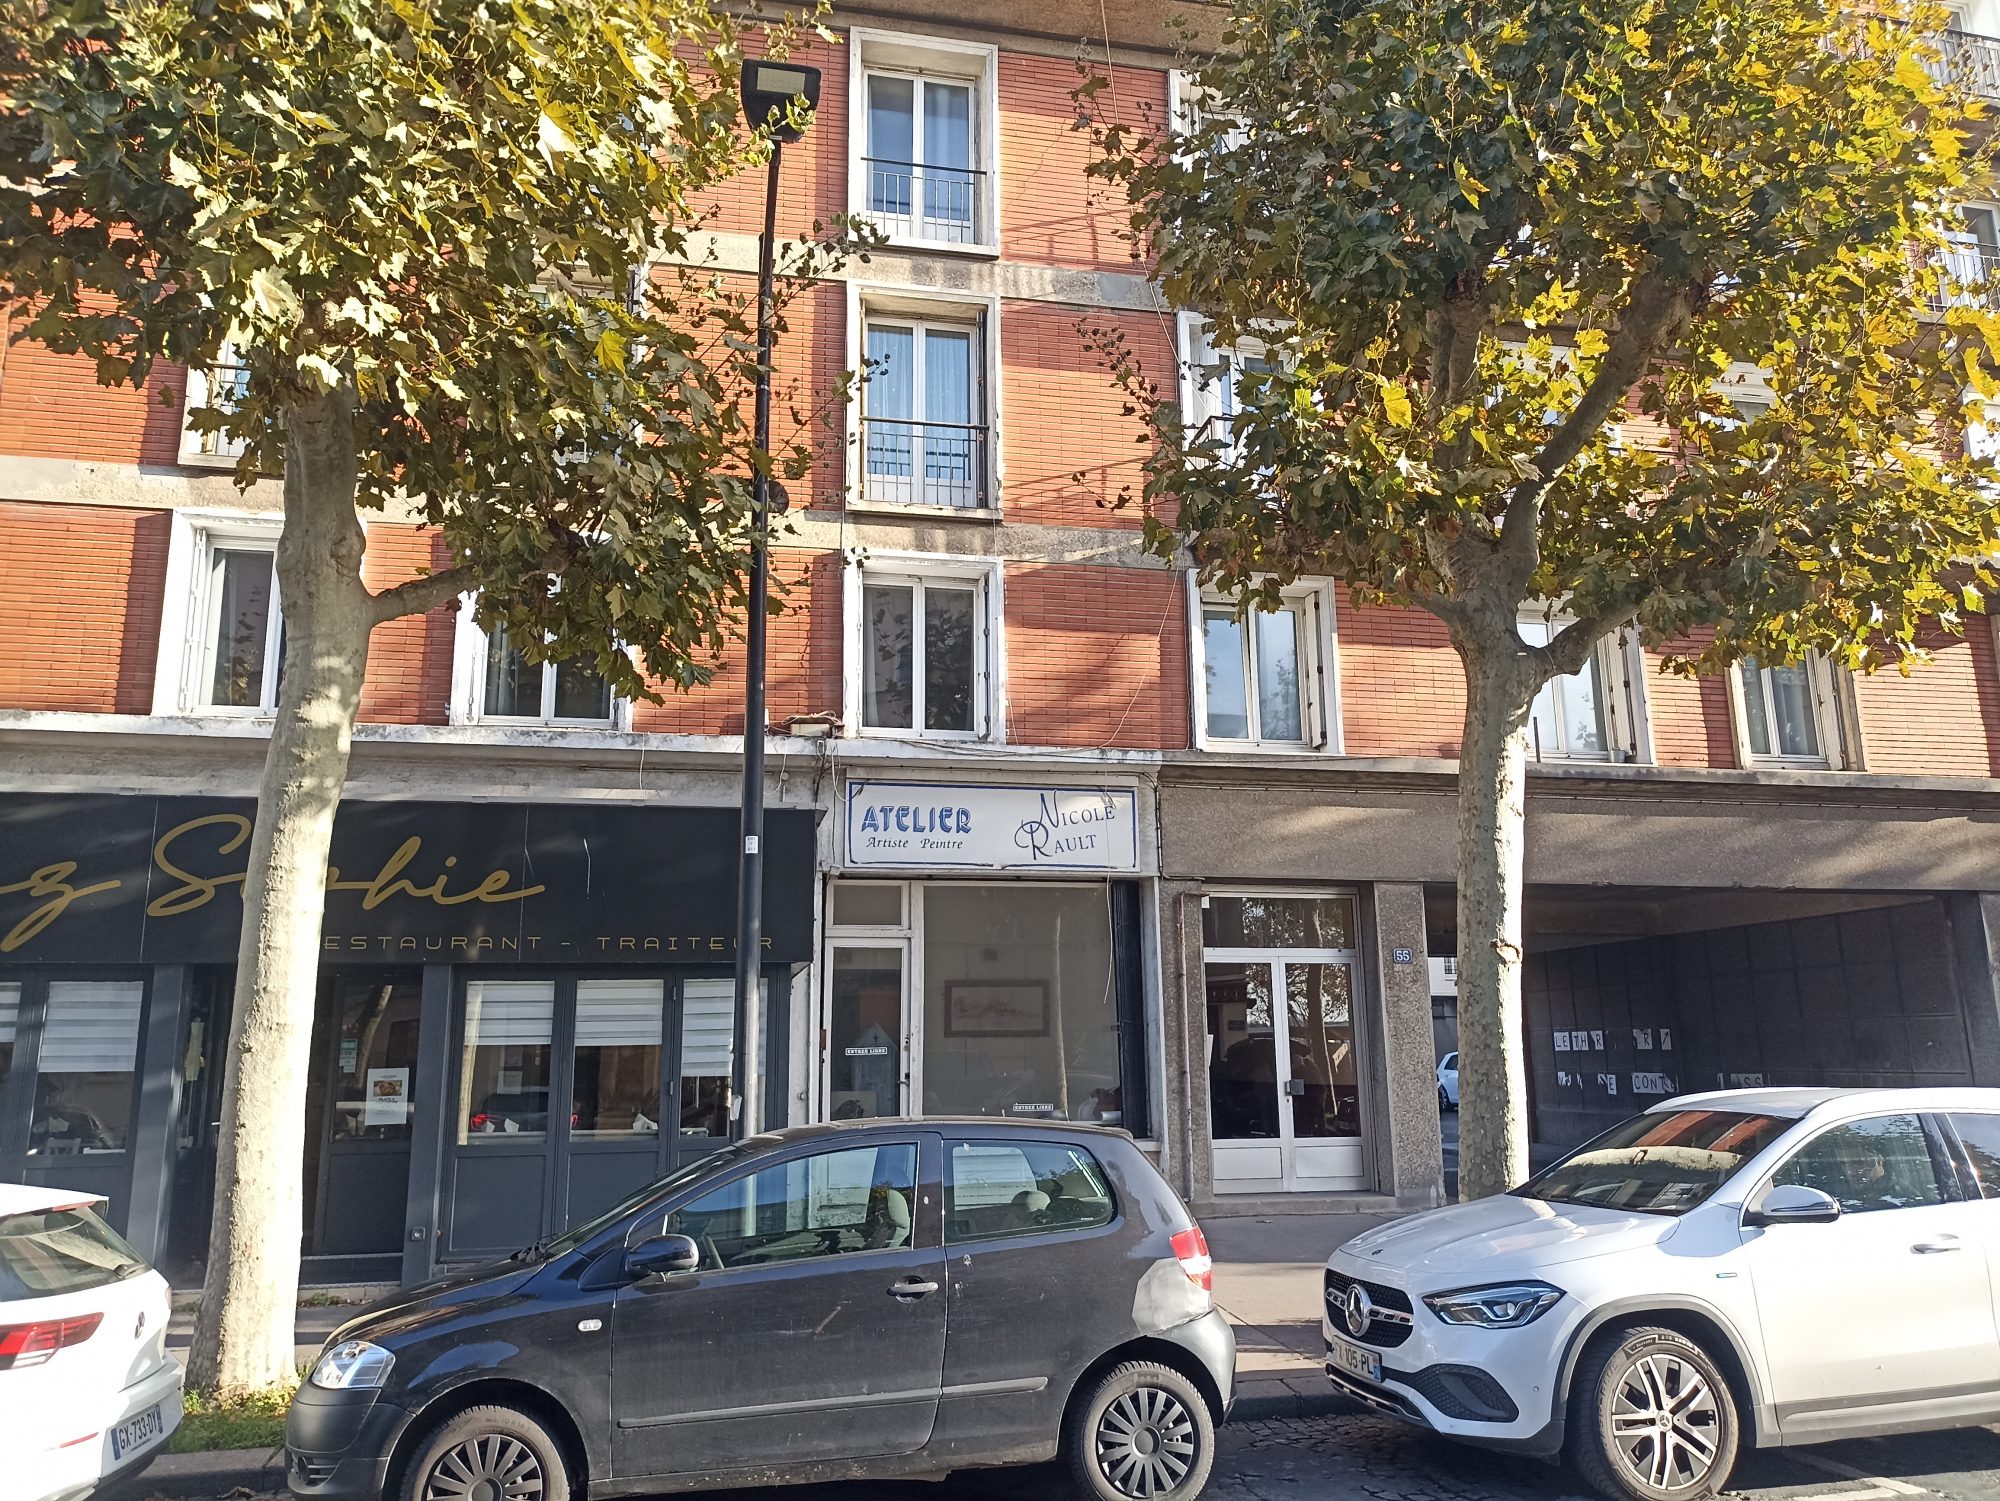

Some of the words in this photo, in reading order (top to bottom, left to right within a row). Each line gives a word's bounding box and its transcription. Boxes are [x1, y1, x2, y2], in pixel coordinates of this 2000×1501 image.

[861, 805, 972, 834] ATELIER
[866, 836, 909, 848] Artiste
[920, 838, 963, 849] Peintre
[323, 936, 542, 950] ESTAURANT
[597, 936, 772, 950] TRAITER
[1396, 950, 1410, 961] 55
